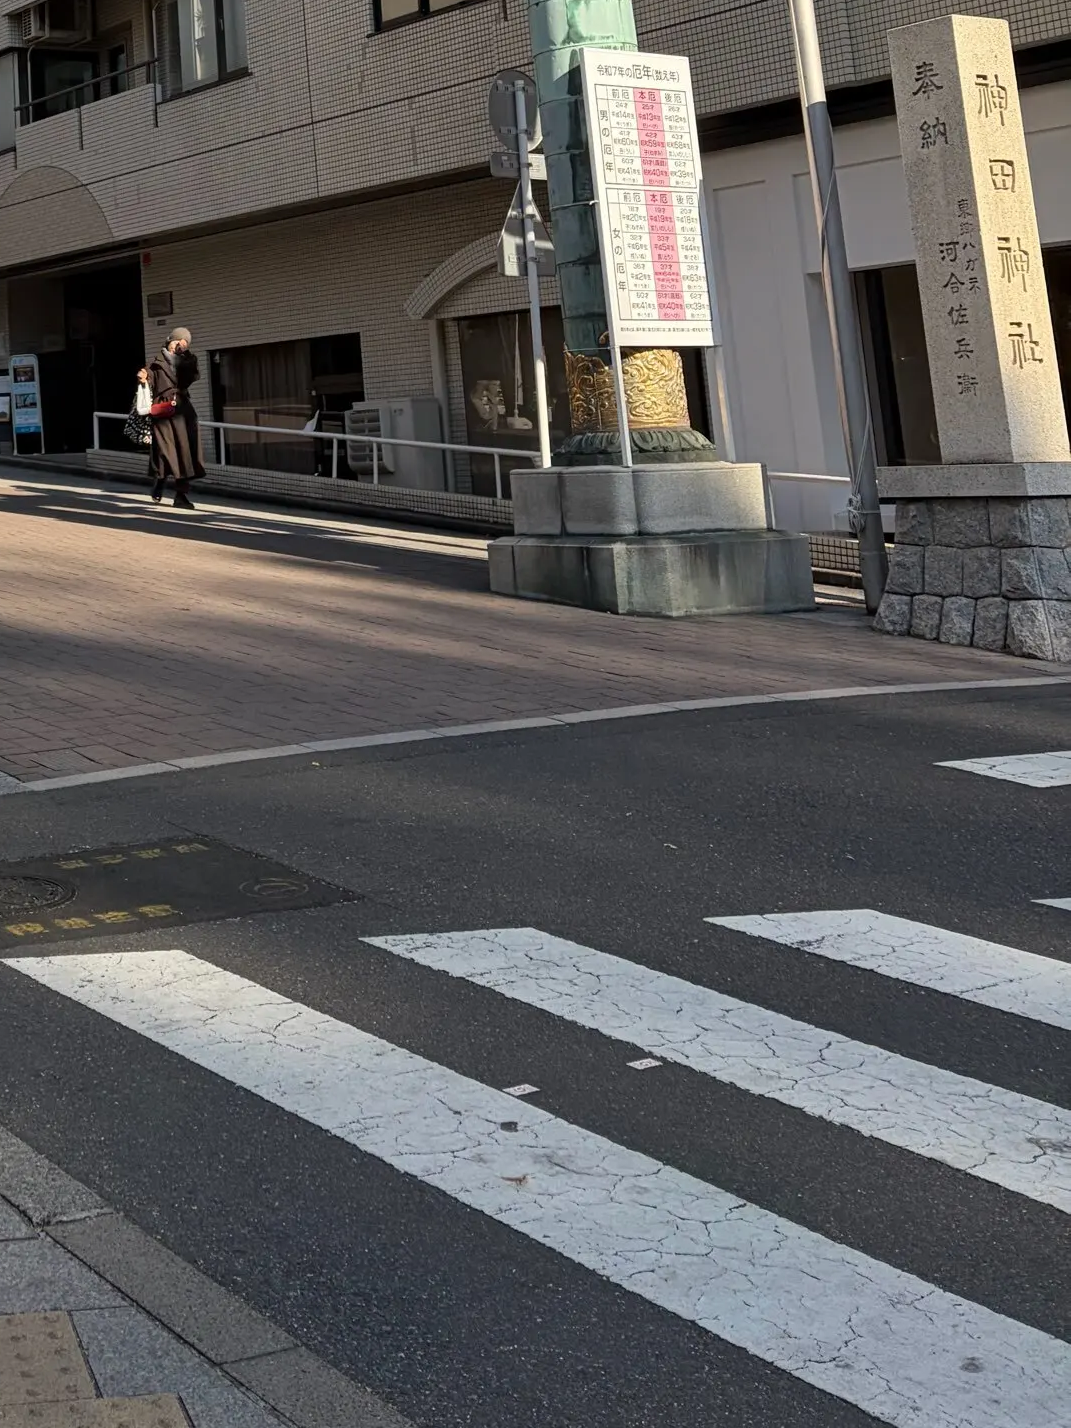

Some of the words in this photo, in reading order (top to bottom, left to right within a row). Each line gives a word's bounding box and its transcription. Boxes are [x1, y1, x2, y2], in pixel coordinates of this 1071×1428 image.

[596, 64, 680, 83] 令和7年の厄年(数え年)
[611, 88, 629, 99] 前厄
[638, 90, 656, 102] 本厄
[664, 92, 682, 103] 後厄
[911, 61, 950, 150] 奉納
[600, 109, 614, 172] 男の厄年
[623, 192, 641, 203] 前厄
[650, 193, 669, 204] 本厄
[676, 194, 694, 206] 後厄
[975, 73, 1045, 370] 神田神社
[612, 227, 628, 292] 女の厄年
